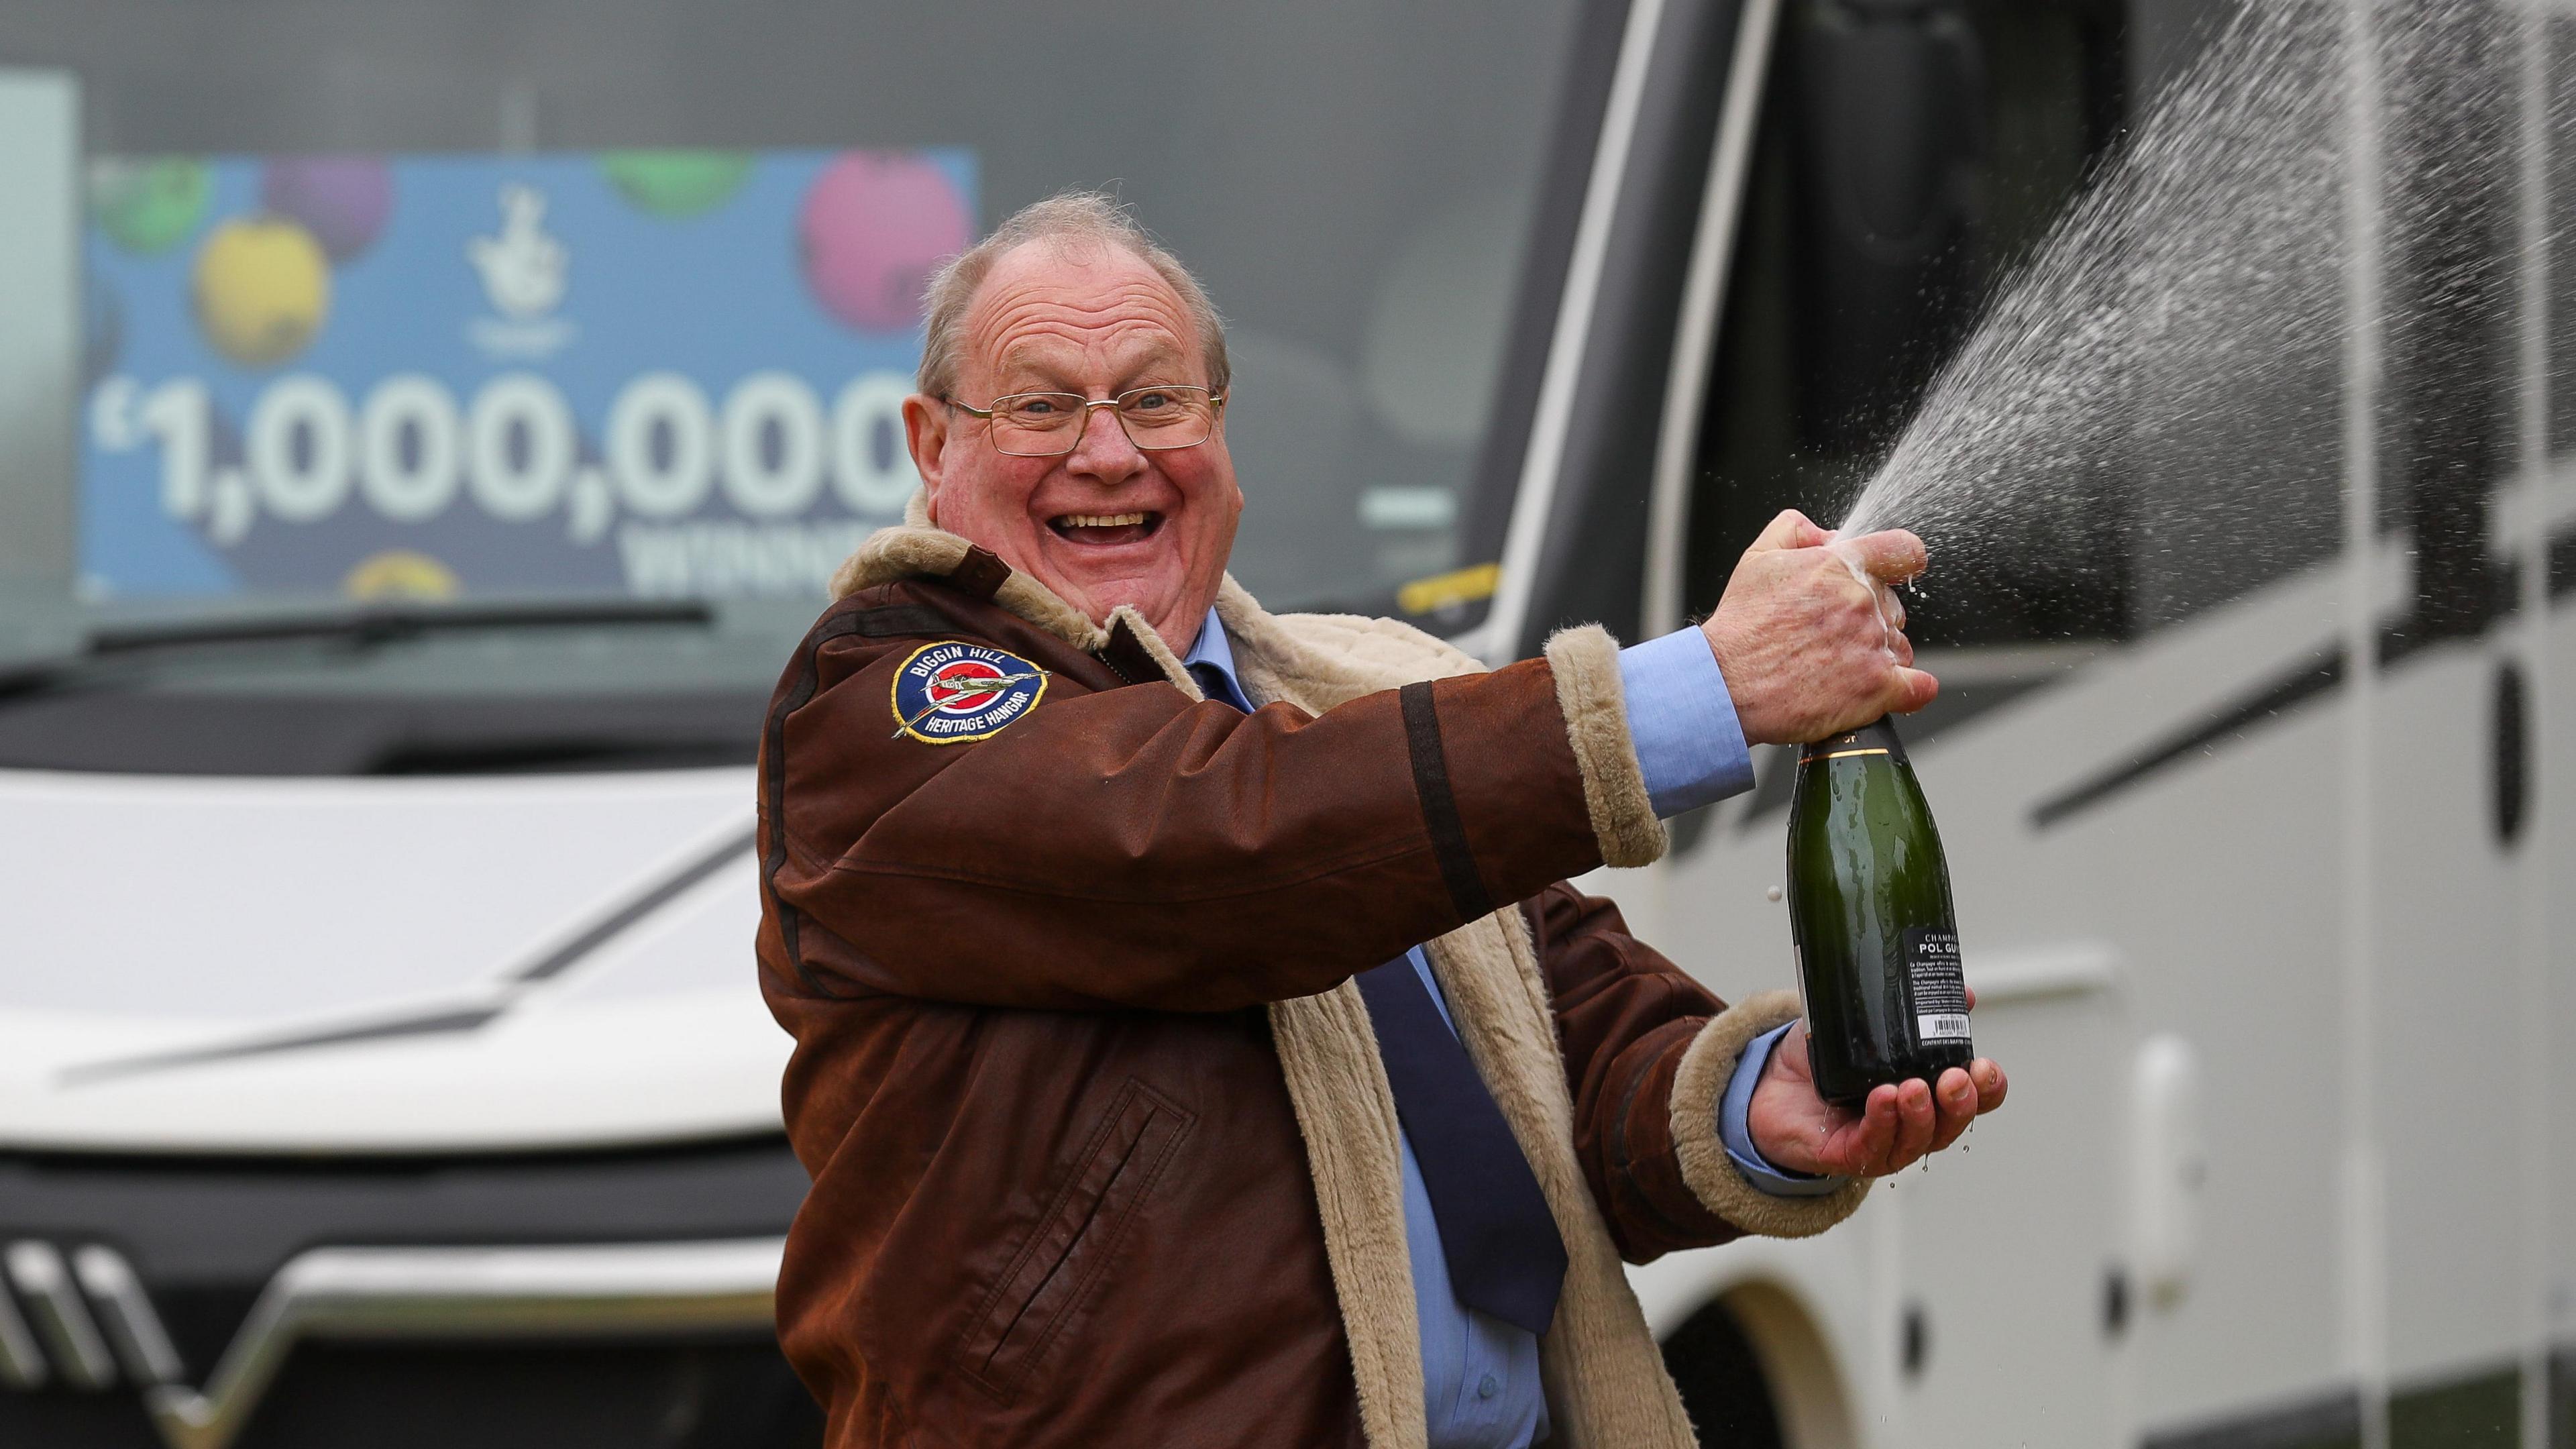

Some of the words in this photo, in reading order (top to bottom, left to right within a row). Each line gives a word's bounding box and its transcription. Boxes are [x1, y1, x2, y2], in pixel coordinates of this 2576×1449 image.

[910, 645, 964, 678] BIGGIN
[969, 647, 1006, 664] HILL
[924, 716, 986, 733] HERITAGE
[984, 691, 1030, 726] HANGAR
[1919, 943, 1943, 953] POL
